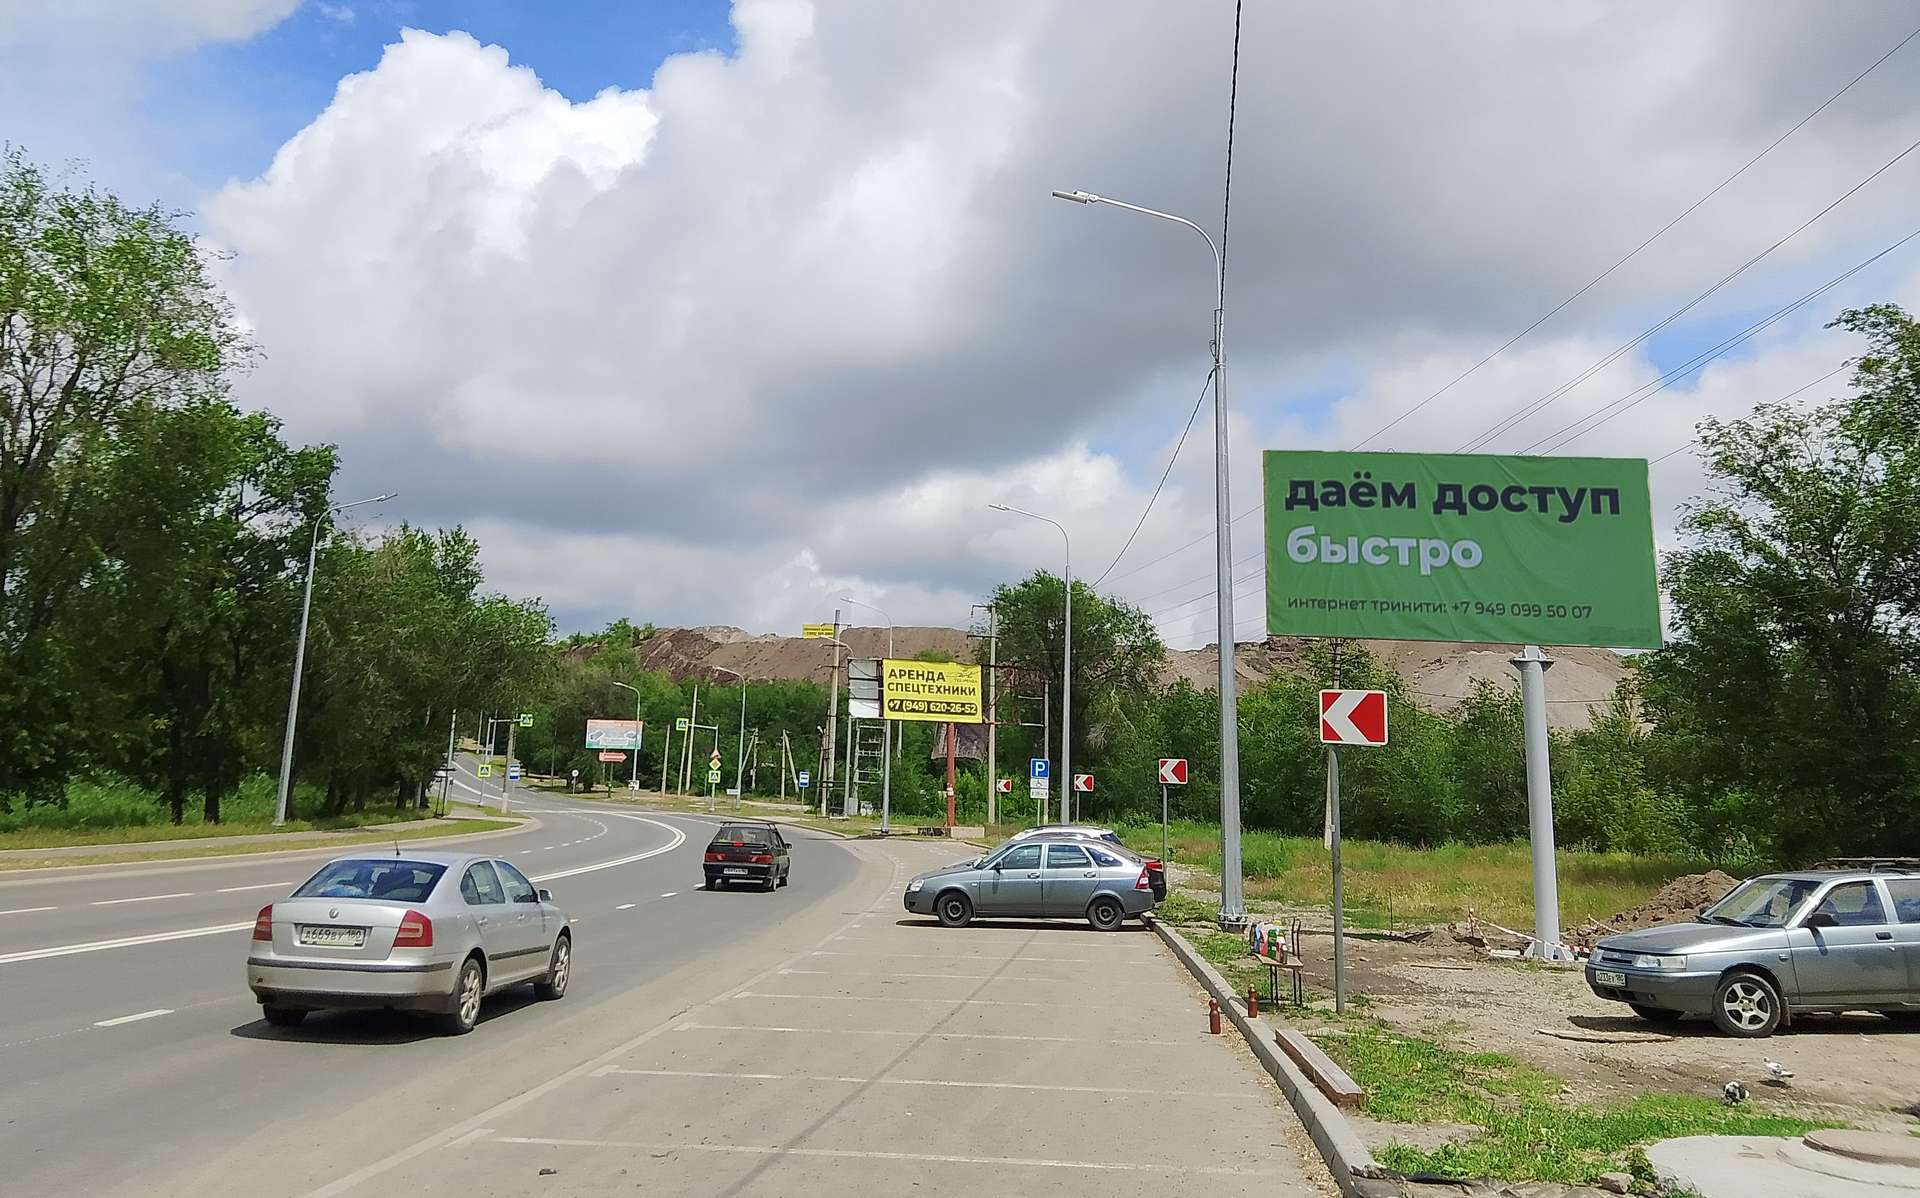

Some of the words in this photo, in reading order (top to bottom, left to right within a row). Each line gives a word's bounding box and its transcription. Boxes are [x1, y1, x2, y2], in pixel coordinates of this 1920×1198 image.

[1284, 471, 1417, 512] даём
[1432, 480, 1621, 524] доступ
[1286, 526, 1484, 576] быстро
[1287, 598, 1367, 612] интернет
[1370, 600, 1448, 616] тринити:
[1451, 601, 1471, 614] +7
[1475, 602, 1506, 615] 949
[1511, 603, 1542, 617] 099
[1546, 605, 1567, 618] 50
[1572, 605, 1593, 619] 07
[888, 669, 946, 683] АРЕНДА
[887, 682, 977, 697] СПЕЦТЕХНИКИ
[889, 700, 901, 709] +7
[902, 701, 928, 712] (949)
[929, 702, 977, 714] 620-26-52
